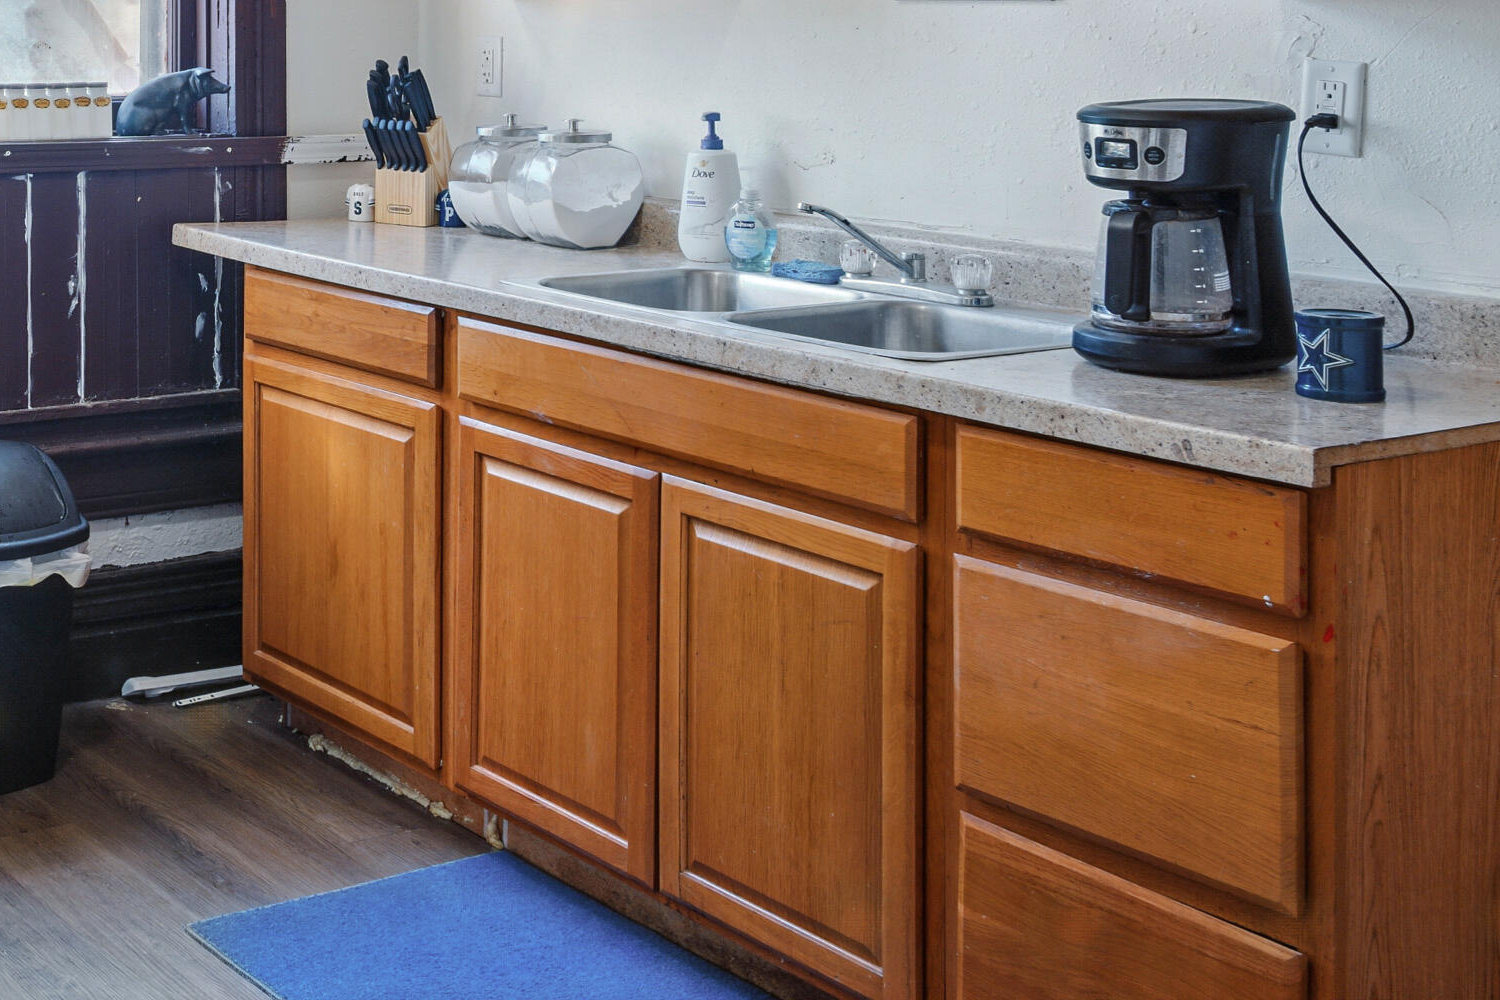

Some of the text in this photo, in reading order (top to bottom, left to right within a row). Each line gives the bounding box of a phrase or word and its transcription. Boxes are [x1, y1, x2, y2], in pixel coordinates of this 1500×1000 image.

[691, 167, 715, 178] Dove
[354, 201, 362, 215] S
[445, 207, 455, 221] P
